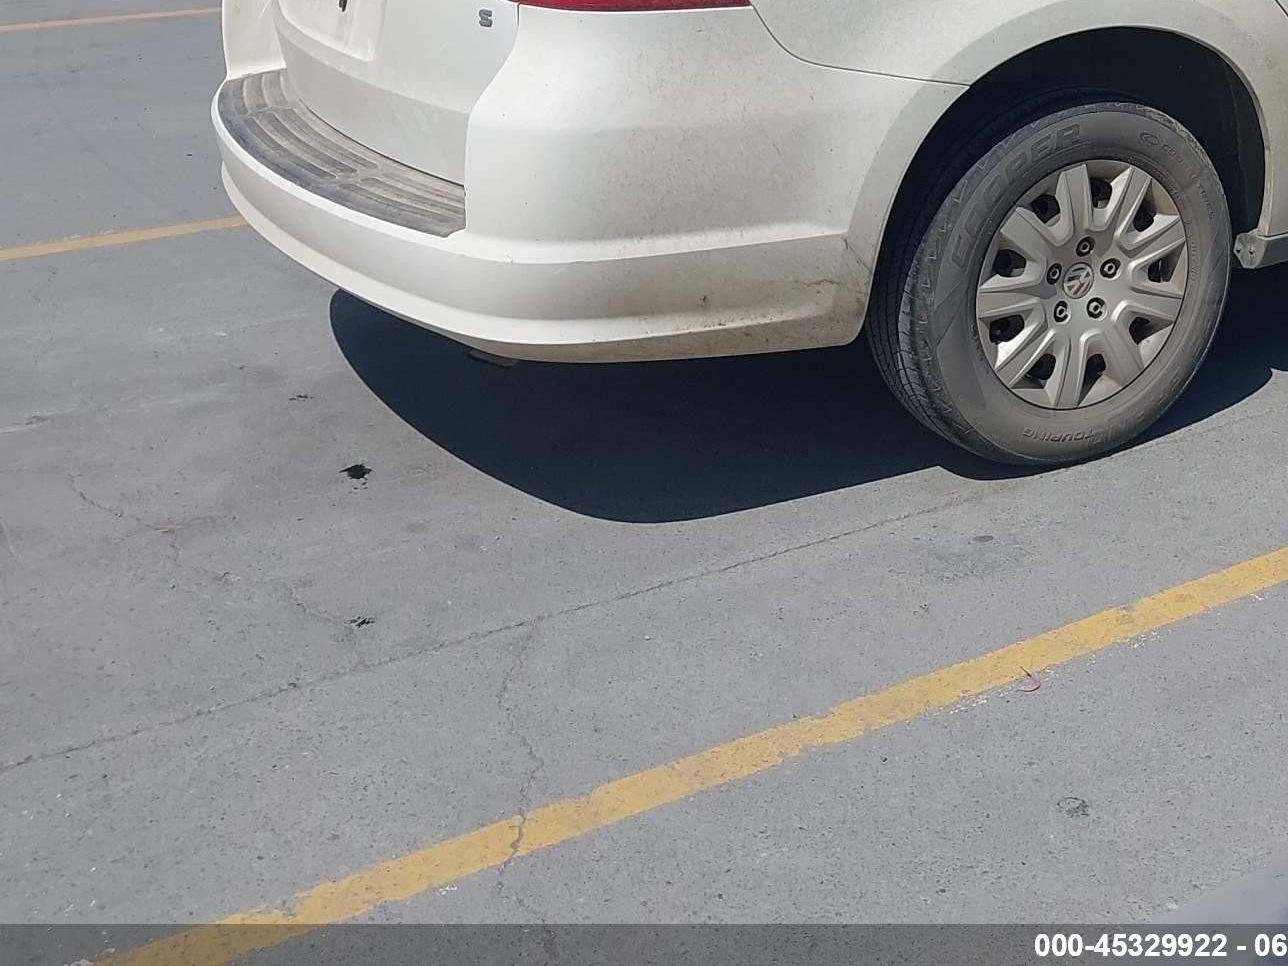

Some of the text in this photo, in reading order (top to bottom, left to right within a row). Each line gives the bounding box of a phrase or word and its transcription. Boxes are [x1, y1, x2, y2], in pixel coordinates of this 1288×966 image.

[479, 9, 493, 27] S
[951, 123, 1081, 269] COOPER
[1021, 425, 1097, 443] TOURING
